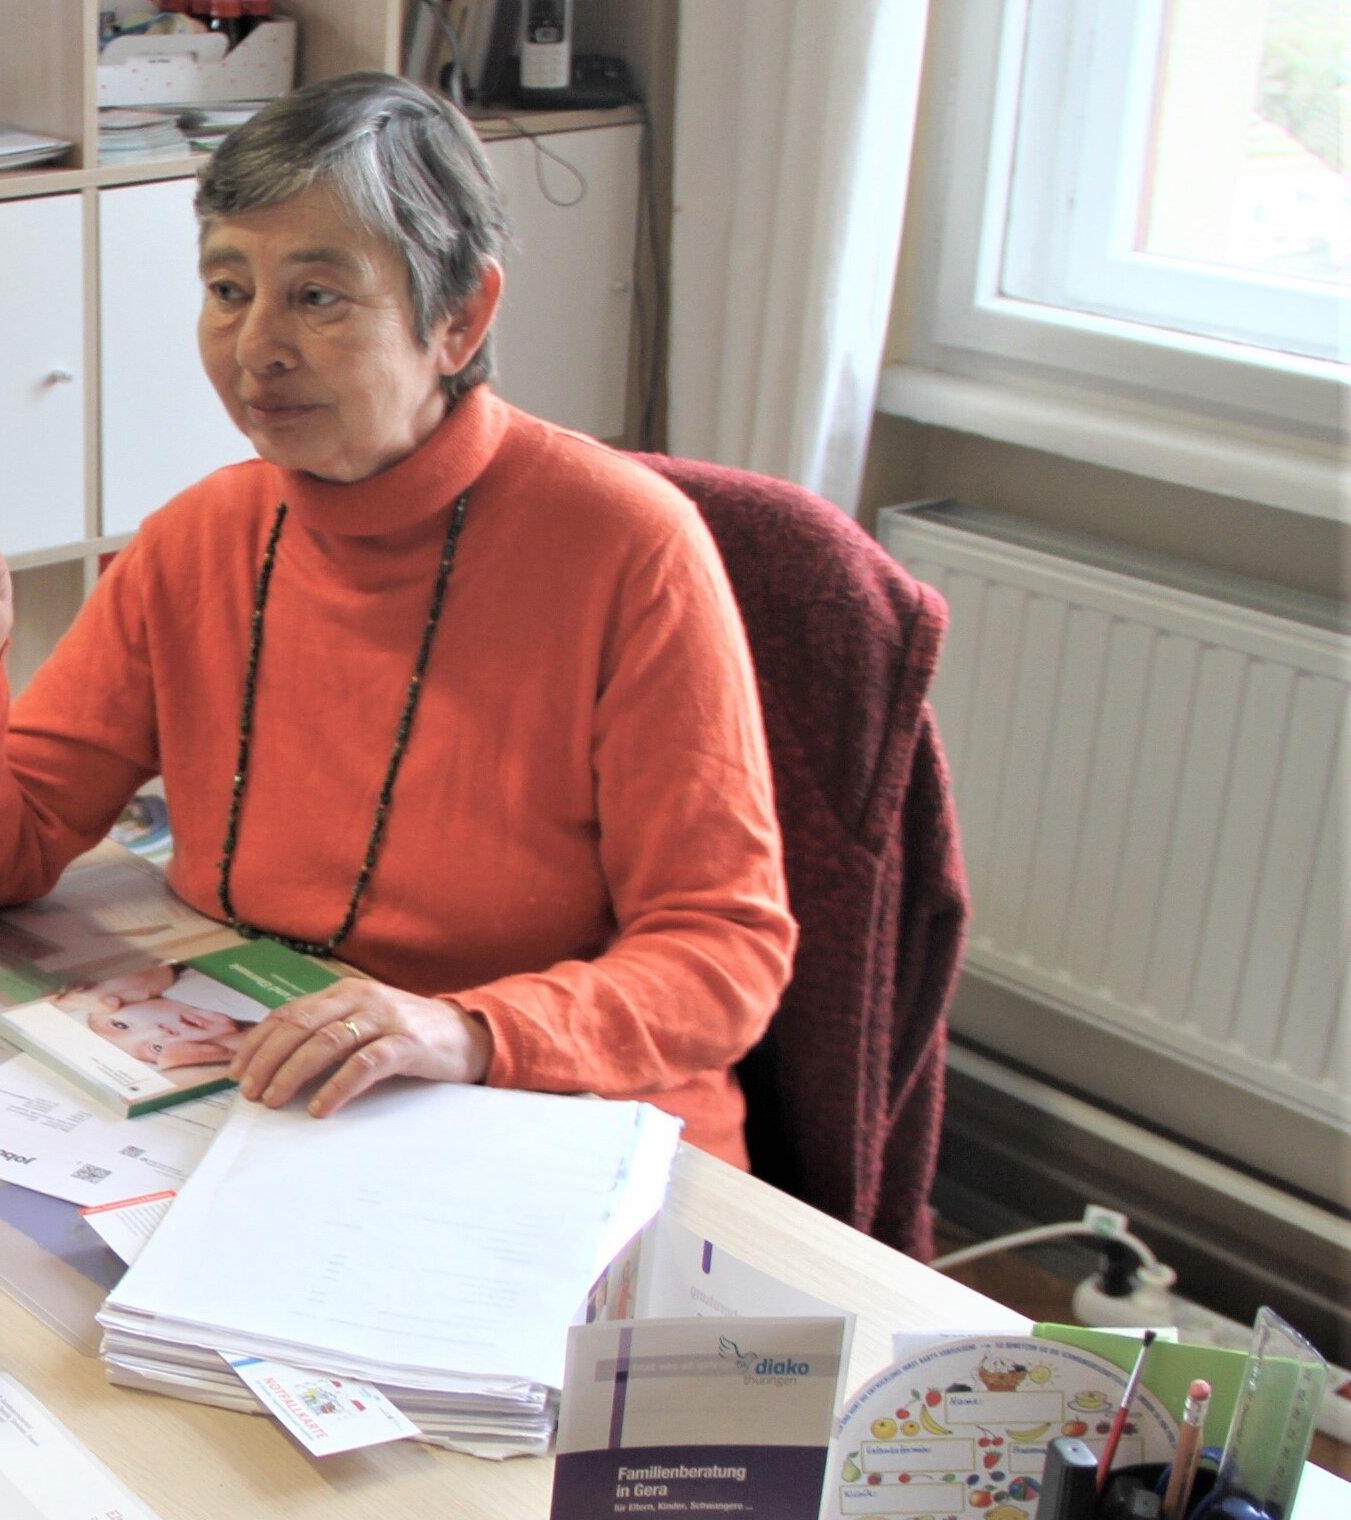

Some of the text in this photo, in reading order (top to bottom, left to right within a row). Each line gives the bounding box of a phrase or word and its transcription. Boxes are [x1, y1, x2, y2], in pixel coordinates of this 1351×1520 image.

[755, 1358, 810, 1375] diako
[263, 1377, 329, 1440] NOTFALLKARTE
[617, 1465, 748, 1482] Familienberatung
[615, 1483, 669, 1498] in Gera
[614, 1503, 627, 1513] für
[690, 1500, 744, 1512] Schwangere
